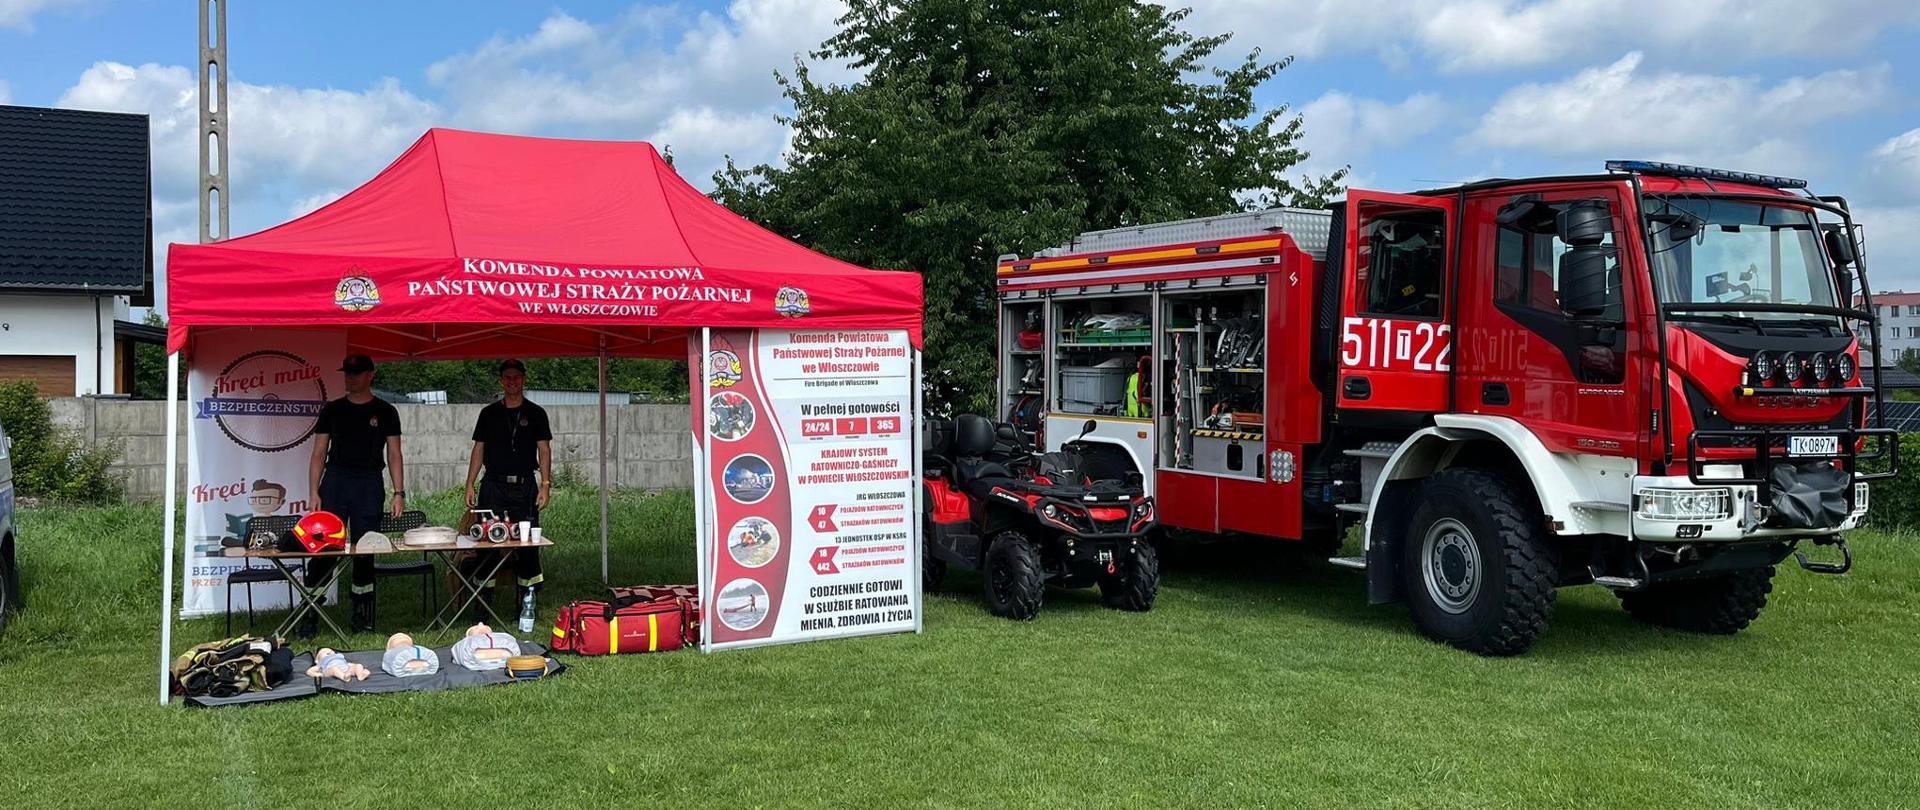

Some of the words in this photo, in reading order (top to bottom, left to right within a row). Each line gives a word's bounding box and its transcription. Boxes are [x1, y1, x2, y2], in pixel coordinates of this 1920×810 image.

[464, 257, 575, 278] KOMENDA
[578, 267, 705, 281] POWIATOWA
[408, 276, 561, 299] PAŃSTWOWEJ
[566, 282, 647, 301] STRAŻY
[651, 283, 752, 303] POŻARNEJ
[518, 302, 543, 314] WE
[547, 303, 658, 316] WŁOSZCZOWIE
[789, 332, 836, 344] Komenda
[838, 332, 890, 343] Powiatowa
[1341, 317, 1392, 368] 511
[1413, 322, 1451, 372] 22
[773, 347, 833, 360] Państwowej
[834, 346, 864, 359] Straży
[865, 345, 906, 358] Pożarnej
[802, 363, 817, 374] we
[215, 371, 266, 394] Kręci
[274, 362, 321, 385] mnie
[804, 380, 816, 388] Fire
[816, 380, 839, 388] Brigade
[209, 401, 324, 414] BEZPIECZEŃSTW
[801, 404, 812, 415] W
[848, 401, 900, 416] gotowości
[804, 421, 830, 433] 24/24
[848, 421, 855, 432] 7
[876, 419, 895, 431] 365
[1793, 437, 1805, 453] TK
[820, 448, 857, 459] KRAJOWY
[858, 447, 888, 458] SYSTEM
[810, 458, 898, 472] RATOWNICZO-GAŚNICZY
[798, 475, 807, 485] W
[807, 473, 844, 485] POWIECIE
[192, 478, 247, 504] Kręci
[856, 493, 867, 501] JRG
[842, 535, 873, 544] JEDNOSTEK
[873, 533, 884, 541] OSP
[810, 583, 864, 598] CODZIENNIE
[865, 579, 903, 593] GOTOWI
[804, 603, 814, 615] W
[816, 599, 853, 614] SŁUŻBIE
[855, 594, 909, 610] RATOWANIA
[800, 617, 836, 632] MIENIA,
[837, 612, 880, 627] ZDROWIA
[881, 611, 885, 623] I
[886, 609, 913, 623] ŻYCIA
